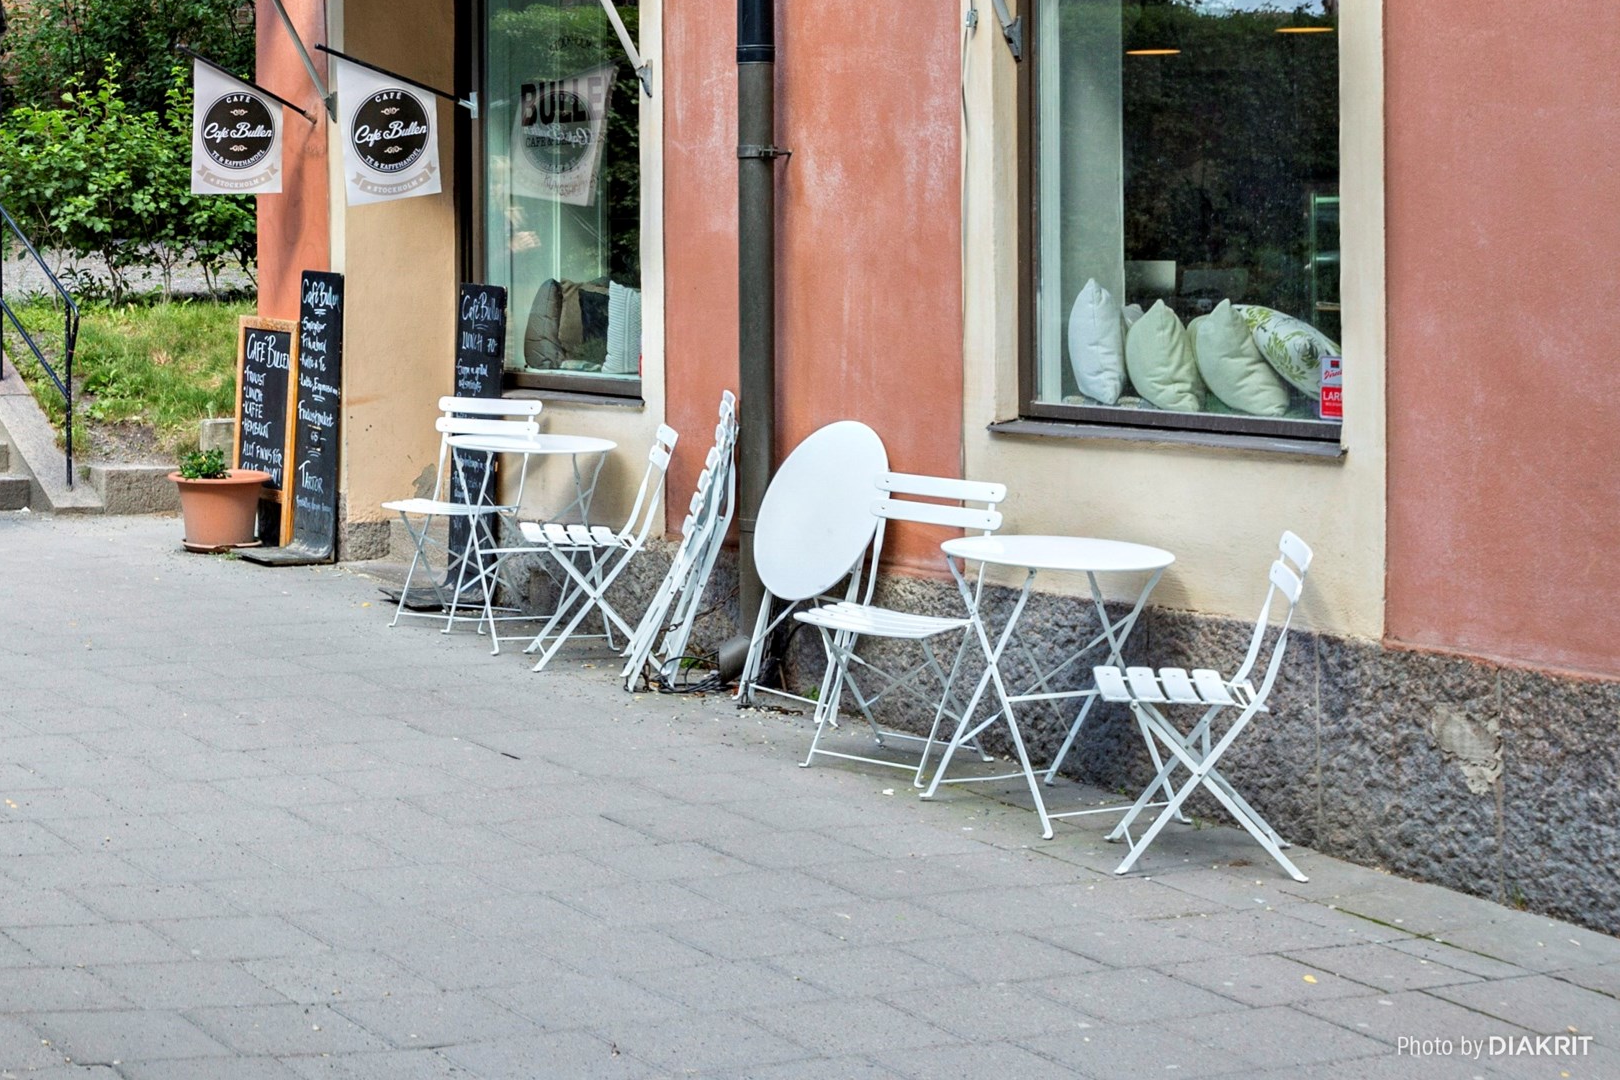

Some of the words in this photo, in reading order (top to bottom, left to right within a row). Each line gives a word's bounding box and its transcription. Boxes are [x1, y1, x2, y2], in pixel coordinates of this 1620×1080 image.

[204, 123, 230, 143] Café
[229, 122, 272, 139] Bullen
[355, 125, 383, 147] Café
[382, 120, 427, 139] Bullen
[225, 149, 265, 166] KAFFEHANDEL
[380, 148, 421, 169] KAFFEHANDEL
[216, 178, 259, 188] STOCKHOLM
[373, 180, 418, 193] STOCKHOLM
[1322, 391, 1342, 401] LAR
